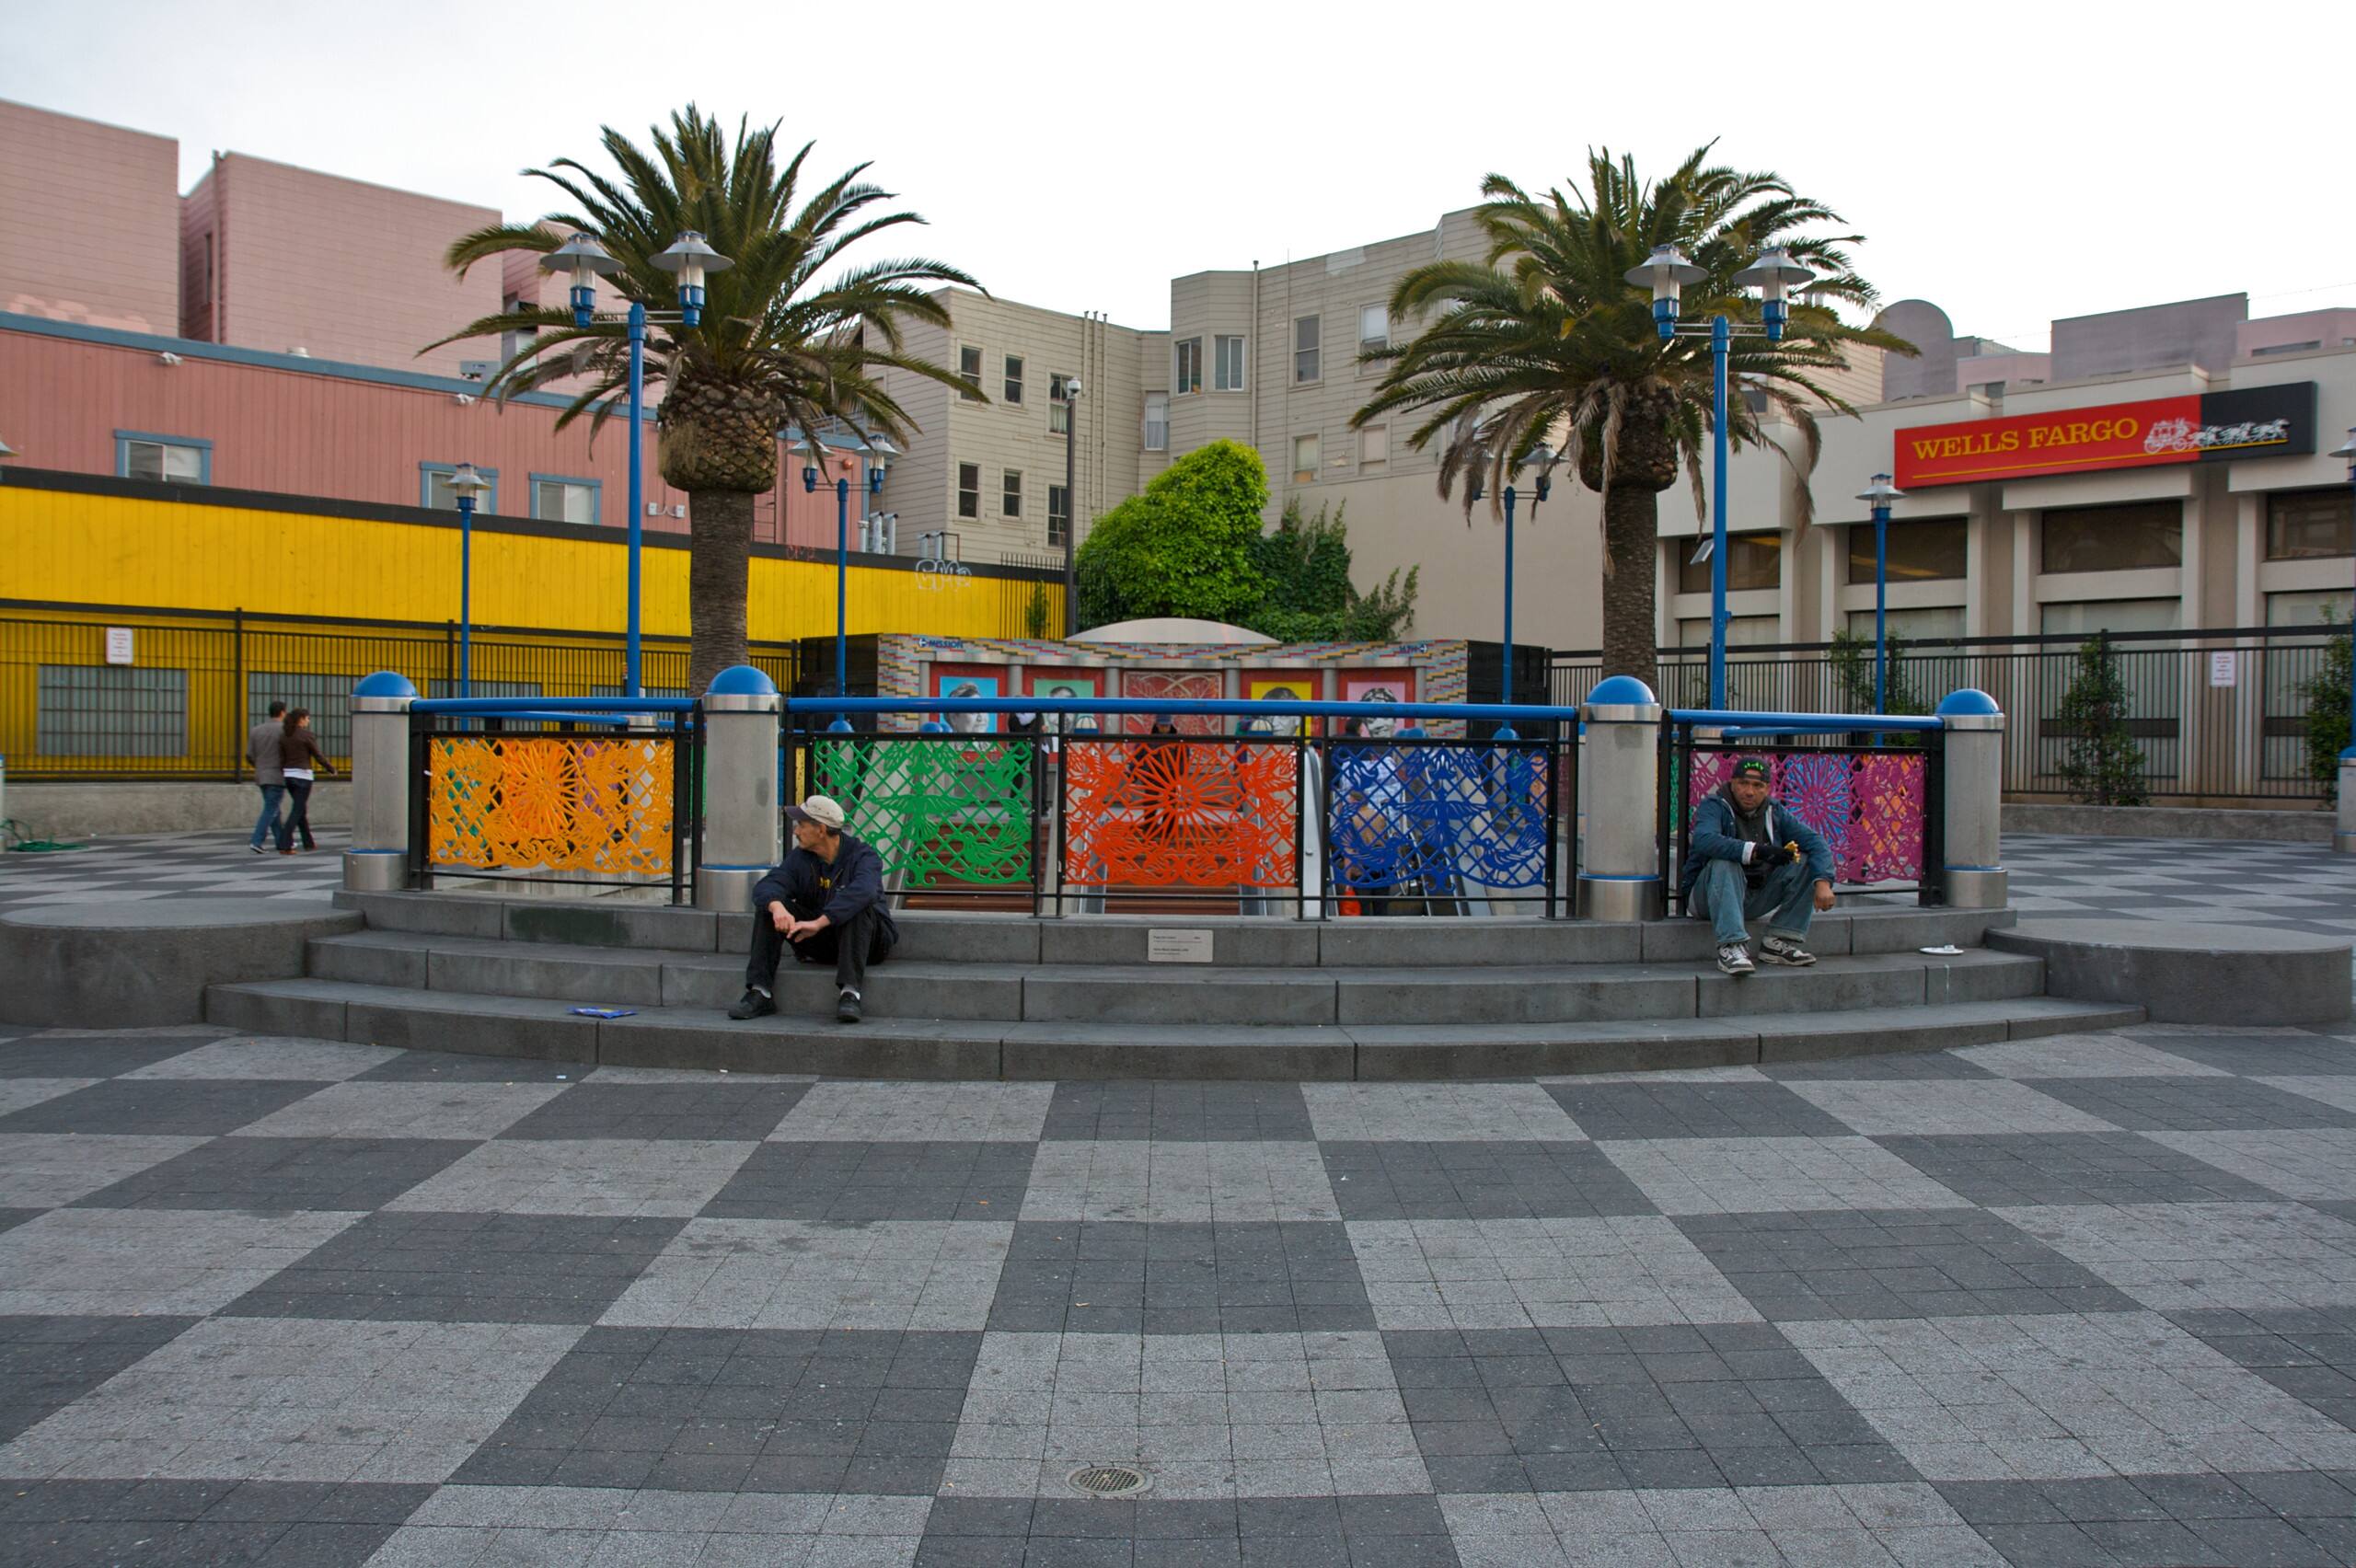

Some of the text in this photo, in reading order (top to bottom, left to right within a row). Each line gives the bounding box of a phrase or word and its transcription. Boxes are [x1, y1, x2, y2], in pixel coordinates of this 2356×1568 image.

[1911, 417, 2140, 460] WELLS FARGO
[928, 640, 964, 649] MISSION
